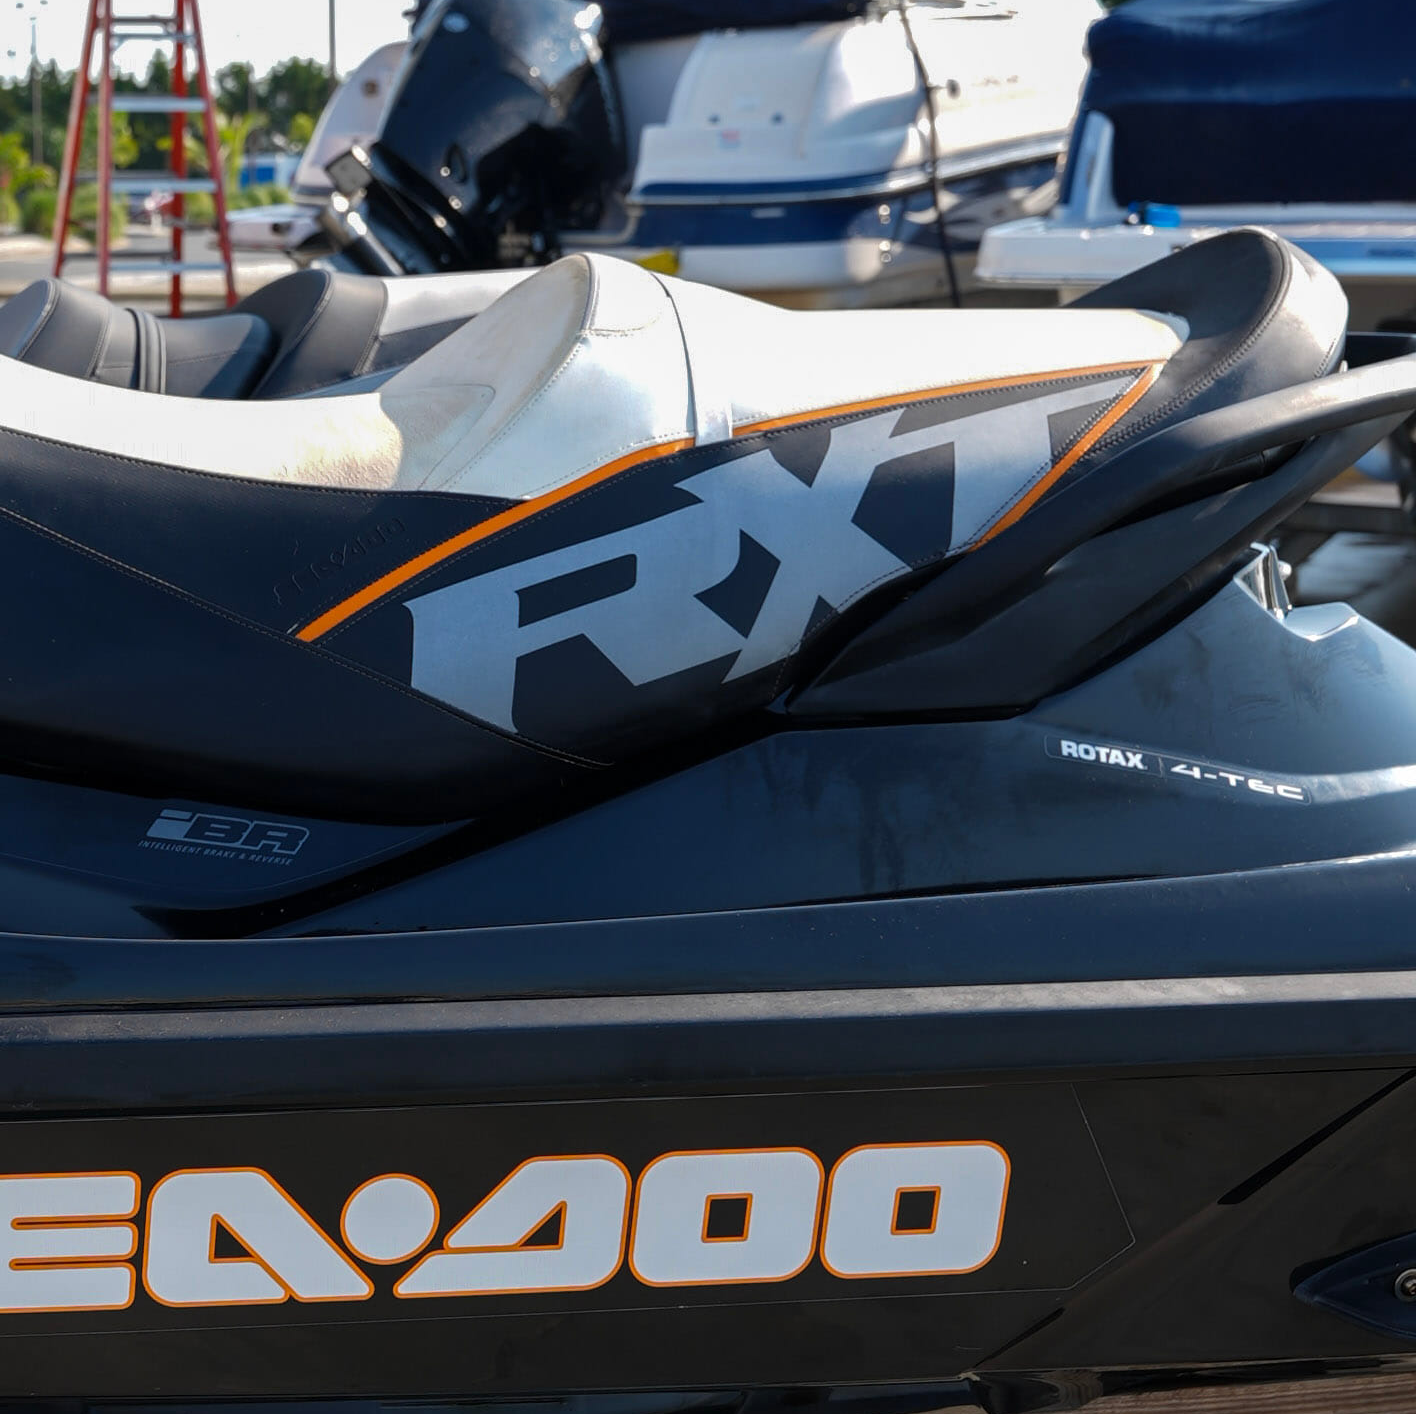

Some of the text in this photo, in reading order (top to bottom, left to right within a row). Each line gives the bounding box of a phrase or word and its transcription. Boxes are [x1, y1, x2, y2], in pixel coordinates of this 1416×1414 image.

[401, 372, 1142, 735] RXT
[1060, 739, 1304, 801] ROTAX 4-TEC
[138, 840, 294, 866] INTELLIGENT BRAKE & REVERSE
